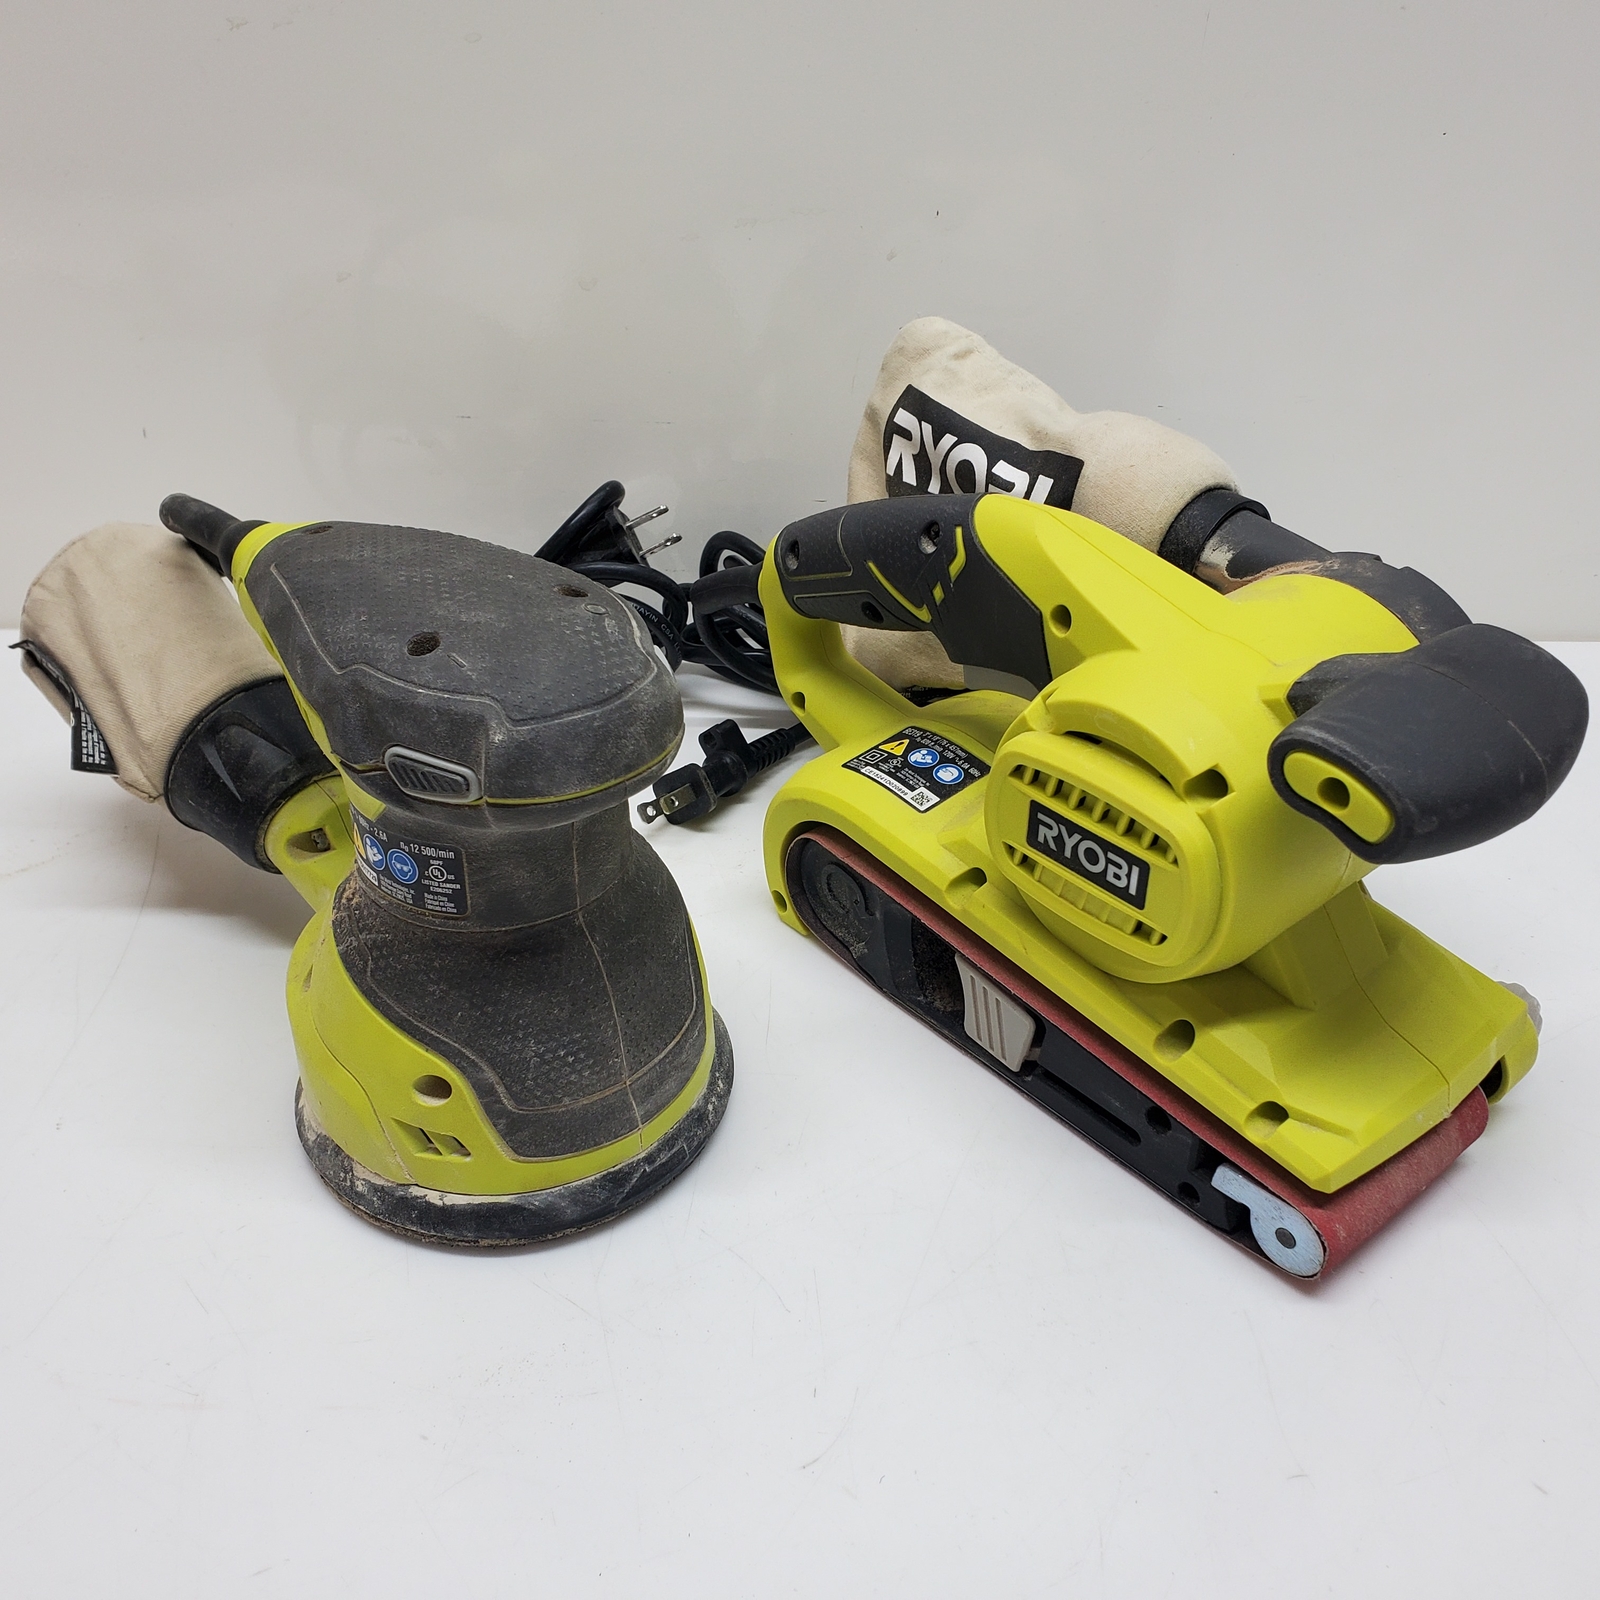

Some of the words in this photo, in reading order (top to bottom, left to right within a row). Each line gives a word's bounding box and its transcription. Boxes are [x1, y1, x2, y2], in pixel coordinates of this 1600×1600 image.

[421, 845, 455, 860] 500/min
[1037, 811, 1140, 896] RYOBI
[421, 879, 439, 887] LISTED
